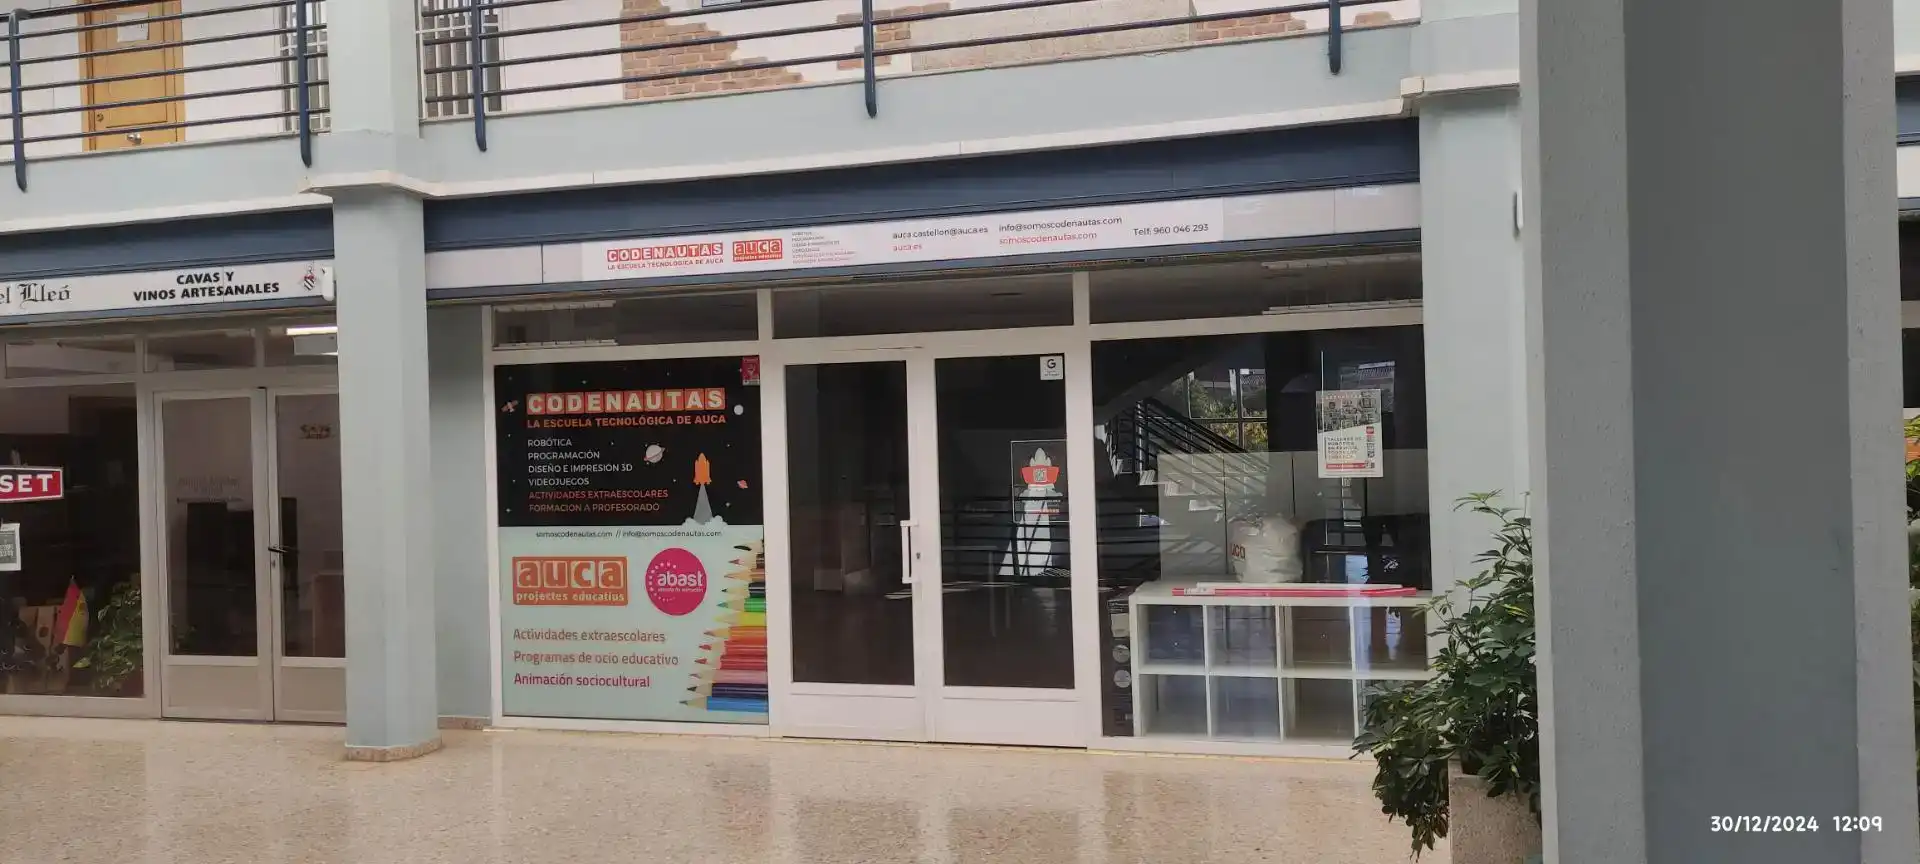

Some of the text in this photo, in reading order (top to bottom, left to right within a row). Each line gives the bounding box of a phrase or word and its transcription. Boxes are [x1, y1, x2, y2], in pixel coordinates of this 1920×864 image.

[999, 217, 1123, 232] info@somoscodenautas.com
[1153, 226, 1170, 235] 960
[1173, 225, 1190, 233] 046
[1192, 223, 1209, 232] 293
[892, 228, 989, 239] auca.castellon@auca.es
[999, 232, 1097, 245] somoscodenautas.com
[607, 243, 723, 262] CODENAUTAS
[734, 240, 781, 255] auca
[176, 271, 235, 285] CAVAS Y
[133, 282, 280, 302] VINOS ARTESANALES
[1047, 358, 1057, 369] G
[527, 389, 725, 414] CODENAUTAS
[527, 415, 726, 428] LA ESCUELA TECNOLÓGICA DE AUCA
[528, 437, 572, 447] ROBÓTICA
[528, 450, 600, 460] PROGRAMACIÓN
[528, 463, 562, 473] DISEÑO
[563, 464, 569, 473] E
[621, 463, 633, 472] 3D
[528, 477, 590, 486] VIDEOJUEGOS
[529, 489, 669, 499] ACTIVIDADES EXTRAESCOLARES
[584, 503, 592, 511] A
[593, 503, 660, 512] PROFESORADO
[535, 530, 613, 538] somoscodenautas.com
[622, 530, 722, 538] info@somoscodenautas.com
[516, 560, 625, 588] auca
[657, 570, 703, 587] abast
[516, 591, 625, 603] projectes educatius
[513, 628, 666, 642] Actividades extraescolares
[514, 650, 679, 666] Programas de ocio educativo
[514, 673, 650, 687] Animación sociocultural
